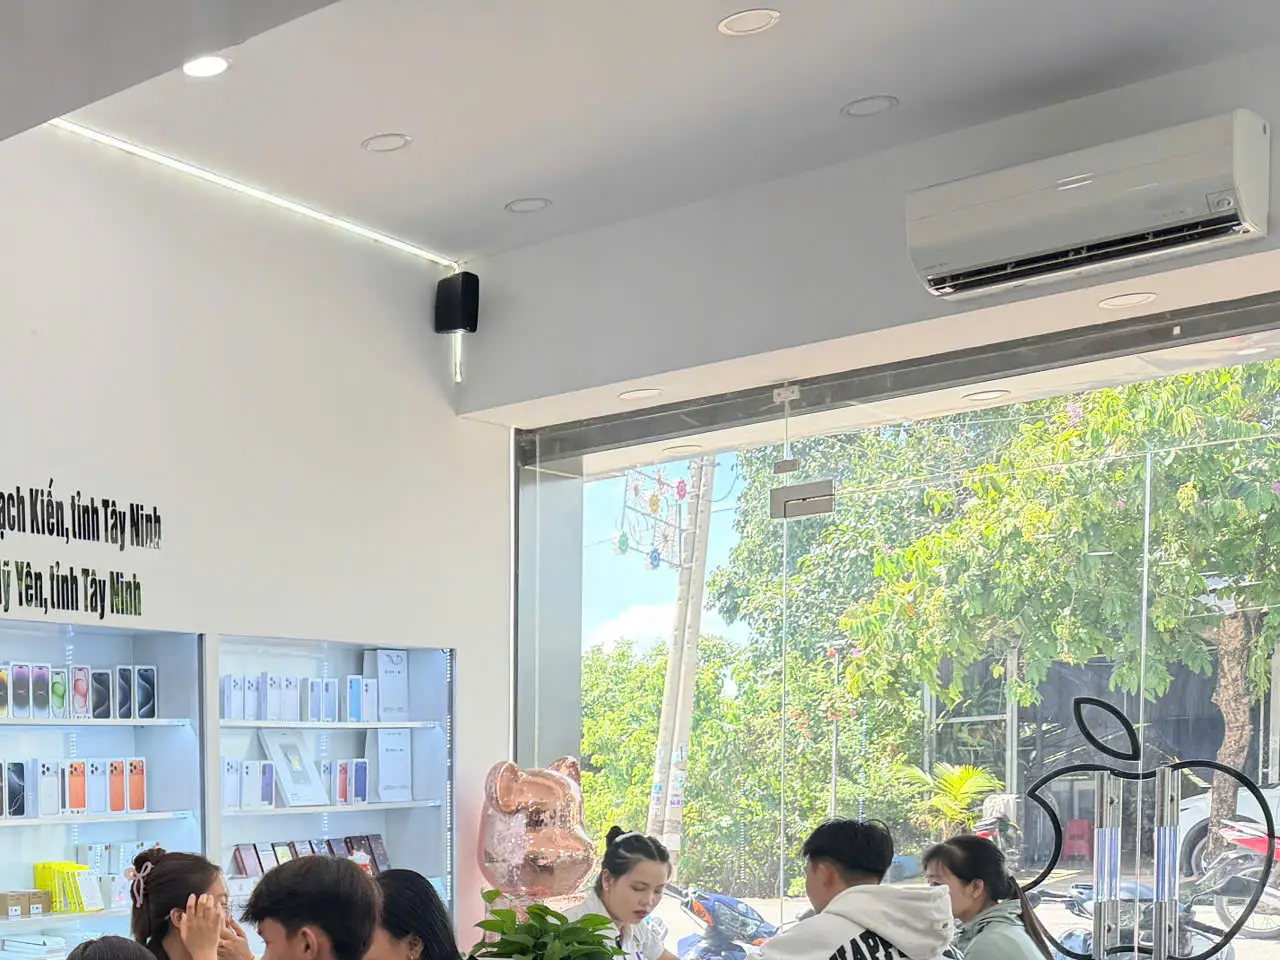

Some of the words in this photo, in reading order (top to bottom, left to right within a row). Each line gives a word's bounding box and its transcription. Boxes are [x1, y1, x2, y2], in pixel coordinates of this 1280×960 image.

[102, 498, 126, 551] Tây
[130, 502, 162, 550] Ninh
[15, 561, 48, 614] Yên,
[81, 568, 106, 620] Tây
[109, 570, 142, 616] Ninh
